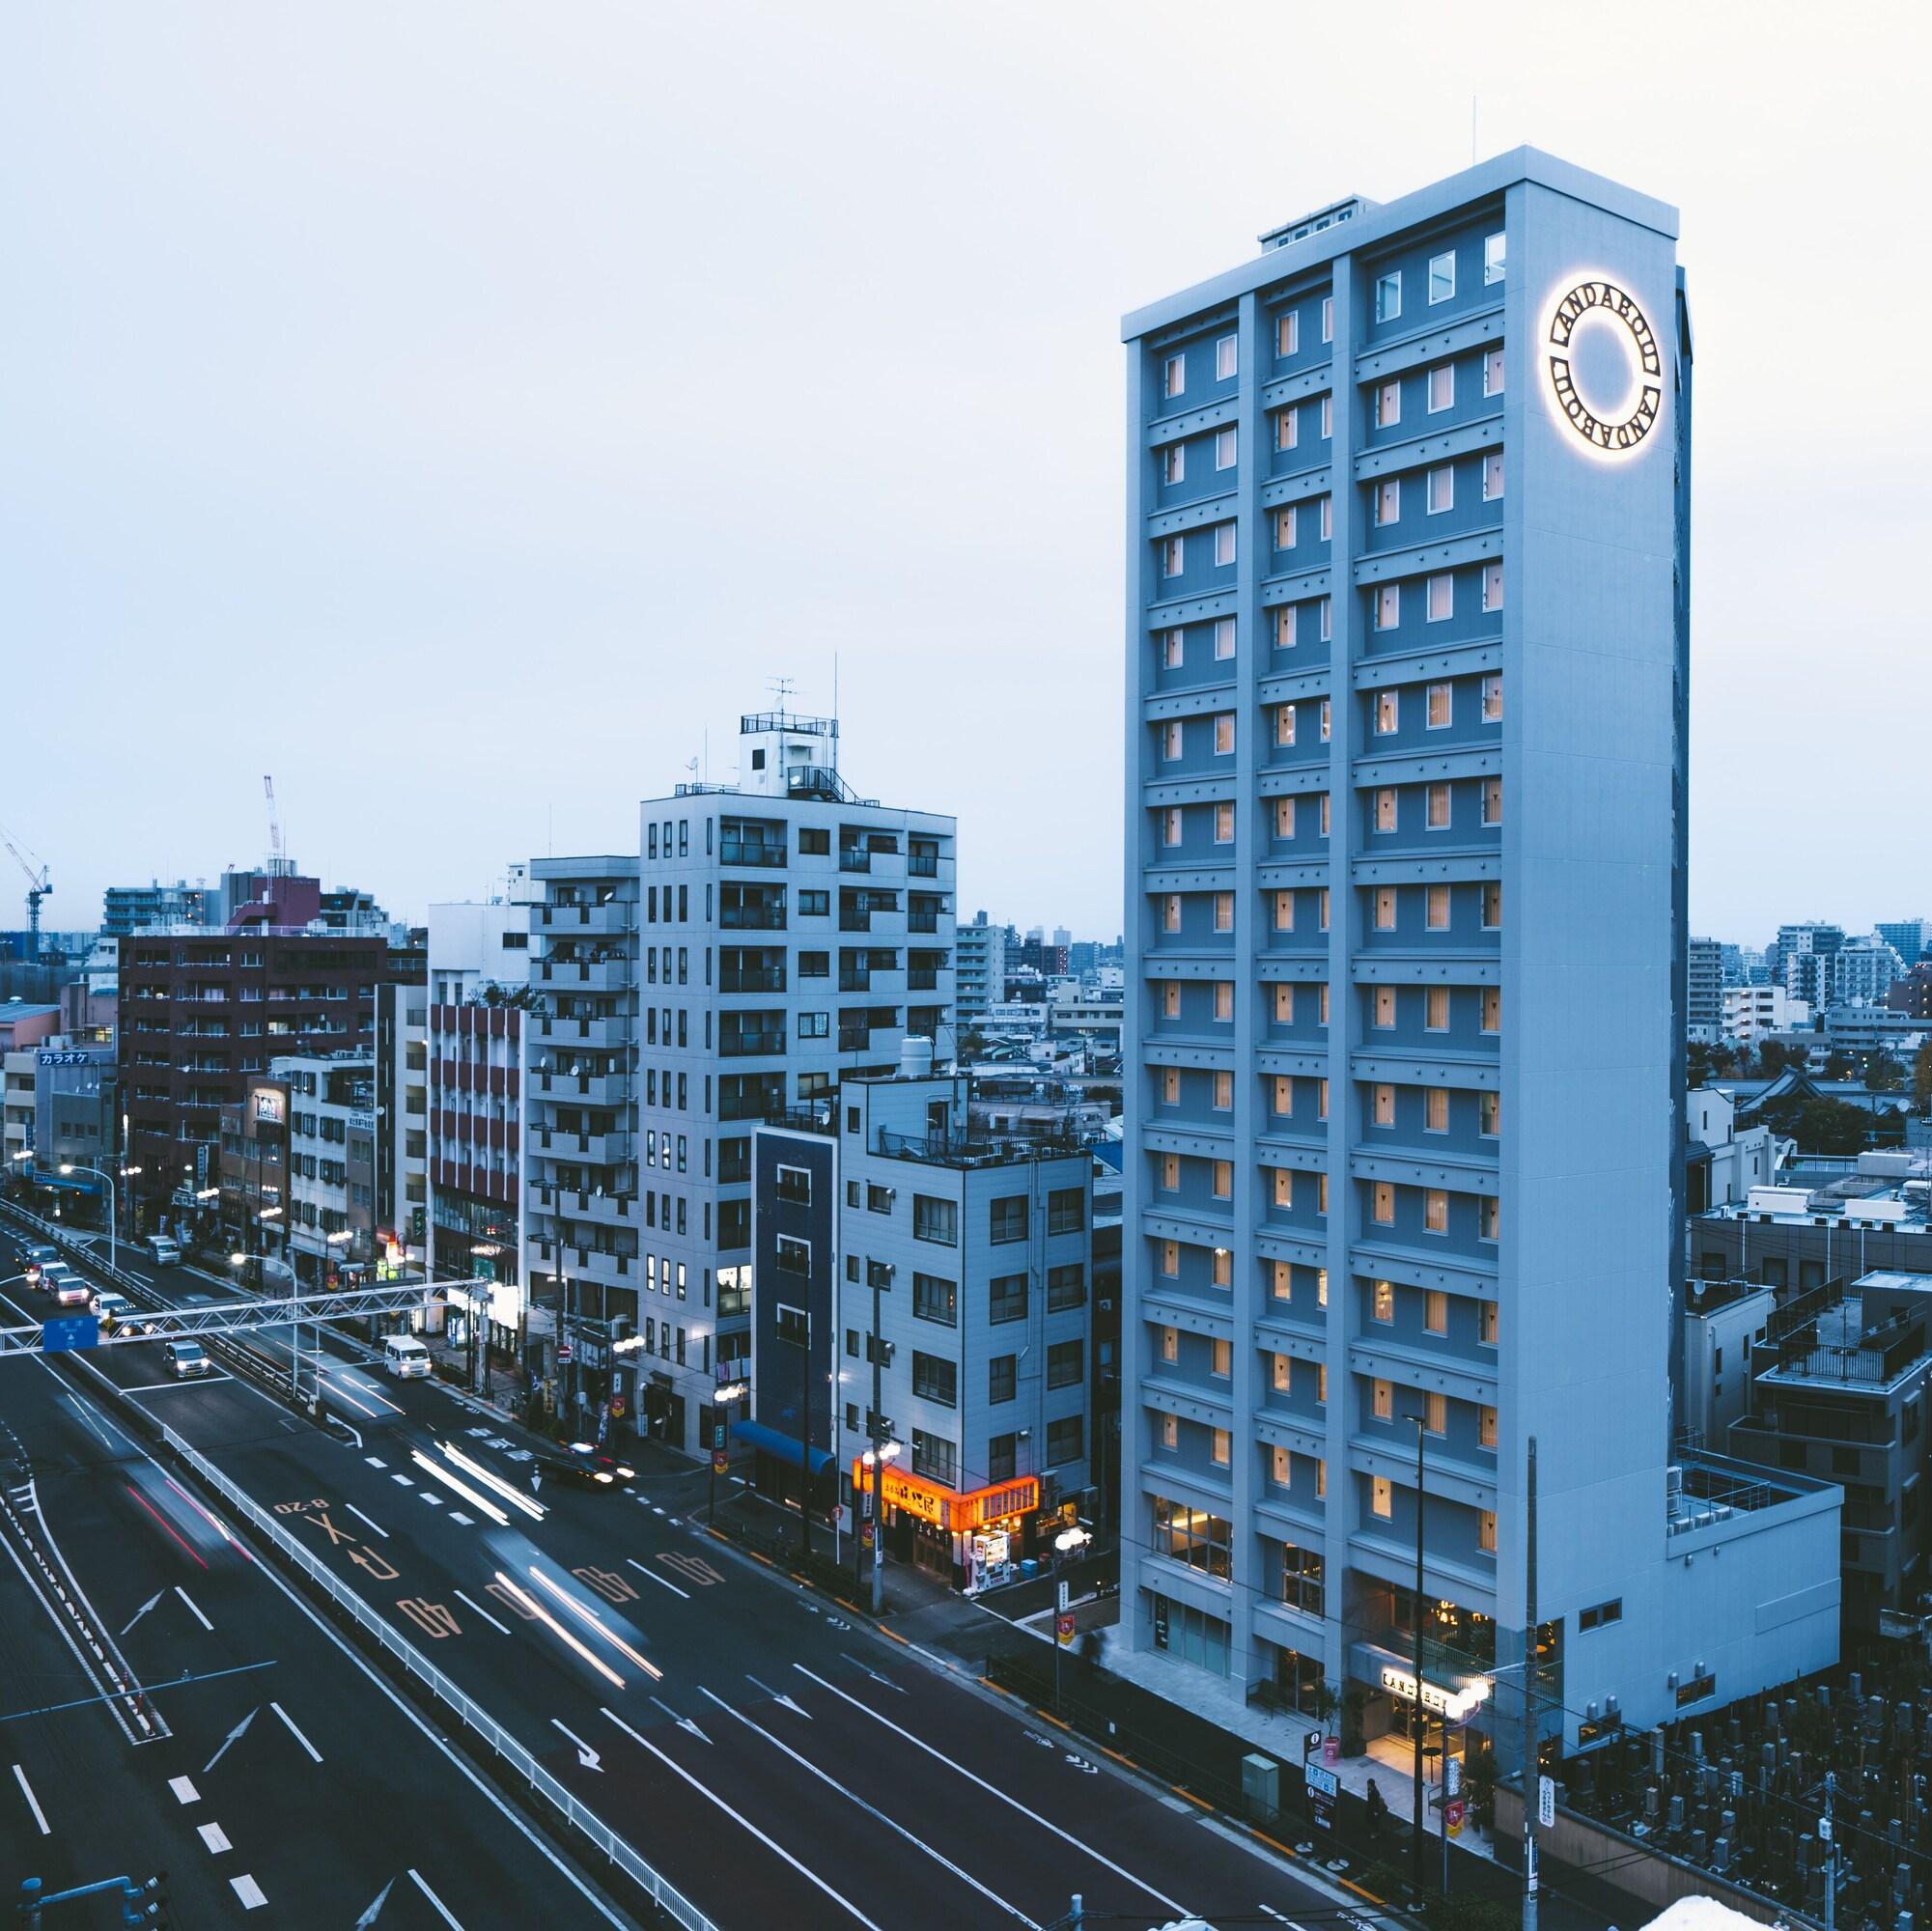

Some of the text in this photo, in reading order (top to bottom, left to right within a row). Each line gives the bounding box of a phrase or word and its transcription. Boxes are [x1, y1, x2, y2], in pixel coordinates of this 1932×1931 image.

[1550, 281, 1661, 378] LANDABOUT
[1550, 355, 1661, 450] LANDABOUT
[42, 1052, 88, 1065] カラオケ
[273, 1498, 330, 1514] 8-20
[572, 1566, 641, 1603] 40
[657, 1551, 726, 1585] 40
[396, 1597, 462, 1638] 40
